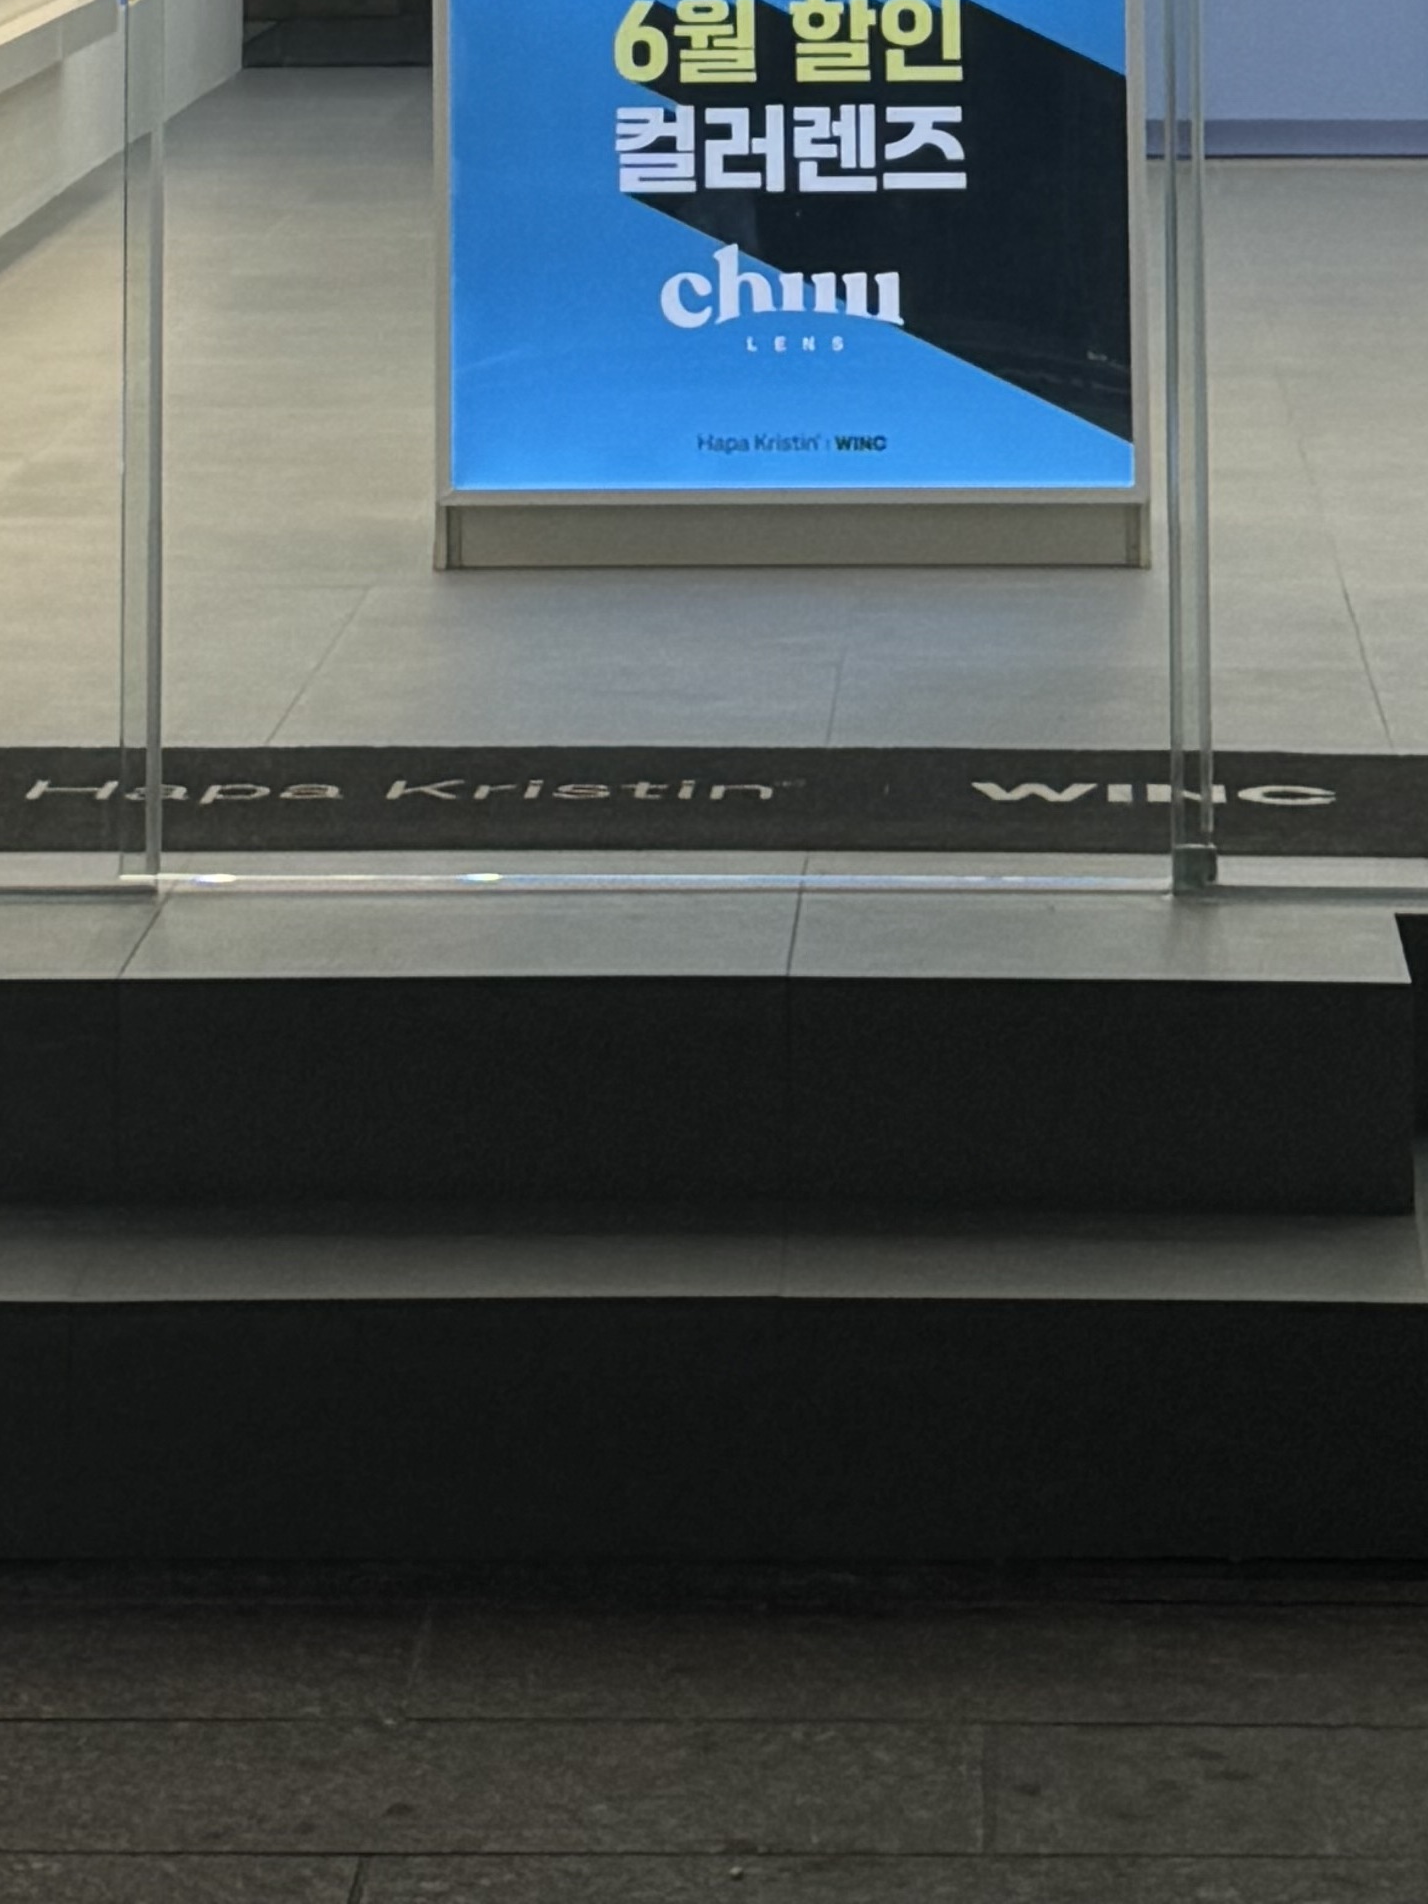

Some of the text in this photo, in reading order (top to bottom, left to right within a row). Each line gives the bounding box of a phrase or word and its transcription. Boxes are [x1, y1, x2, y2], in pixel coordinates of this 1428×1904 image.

[614, 103, 968, 193] 컬러렌즈
[745, 335, 845, 353] LENS
[697, 433, 750, 455] Hapa
[834, 434, 888, 453] WINC
[22, 777, 344, 806] Hapa
[970, 780, 1338, 806] WINC
